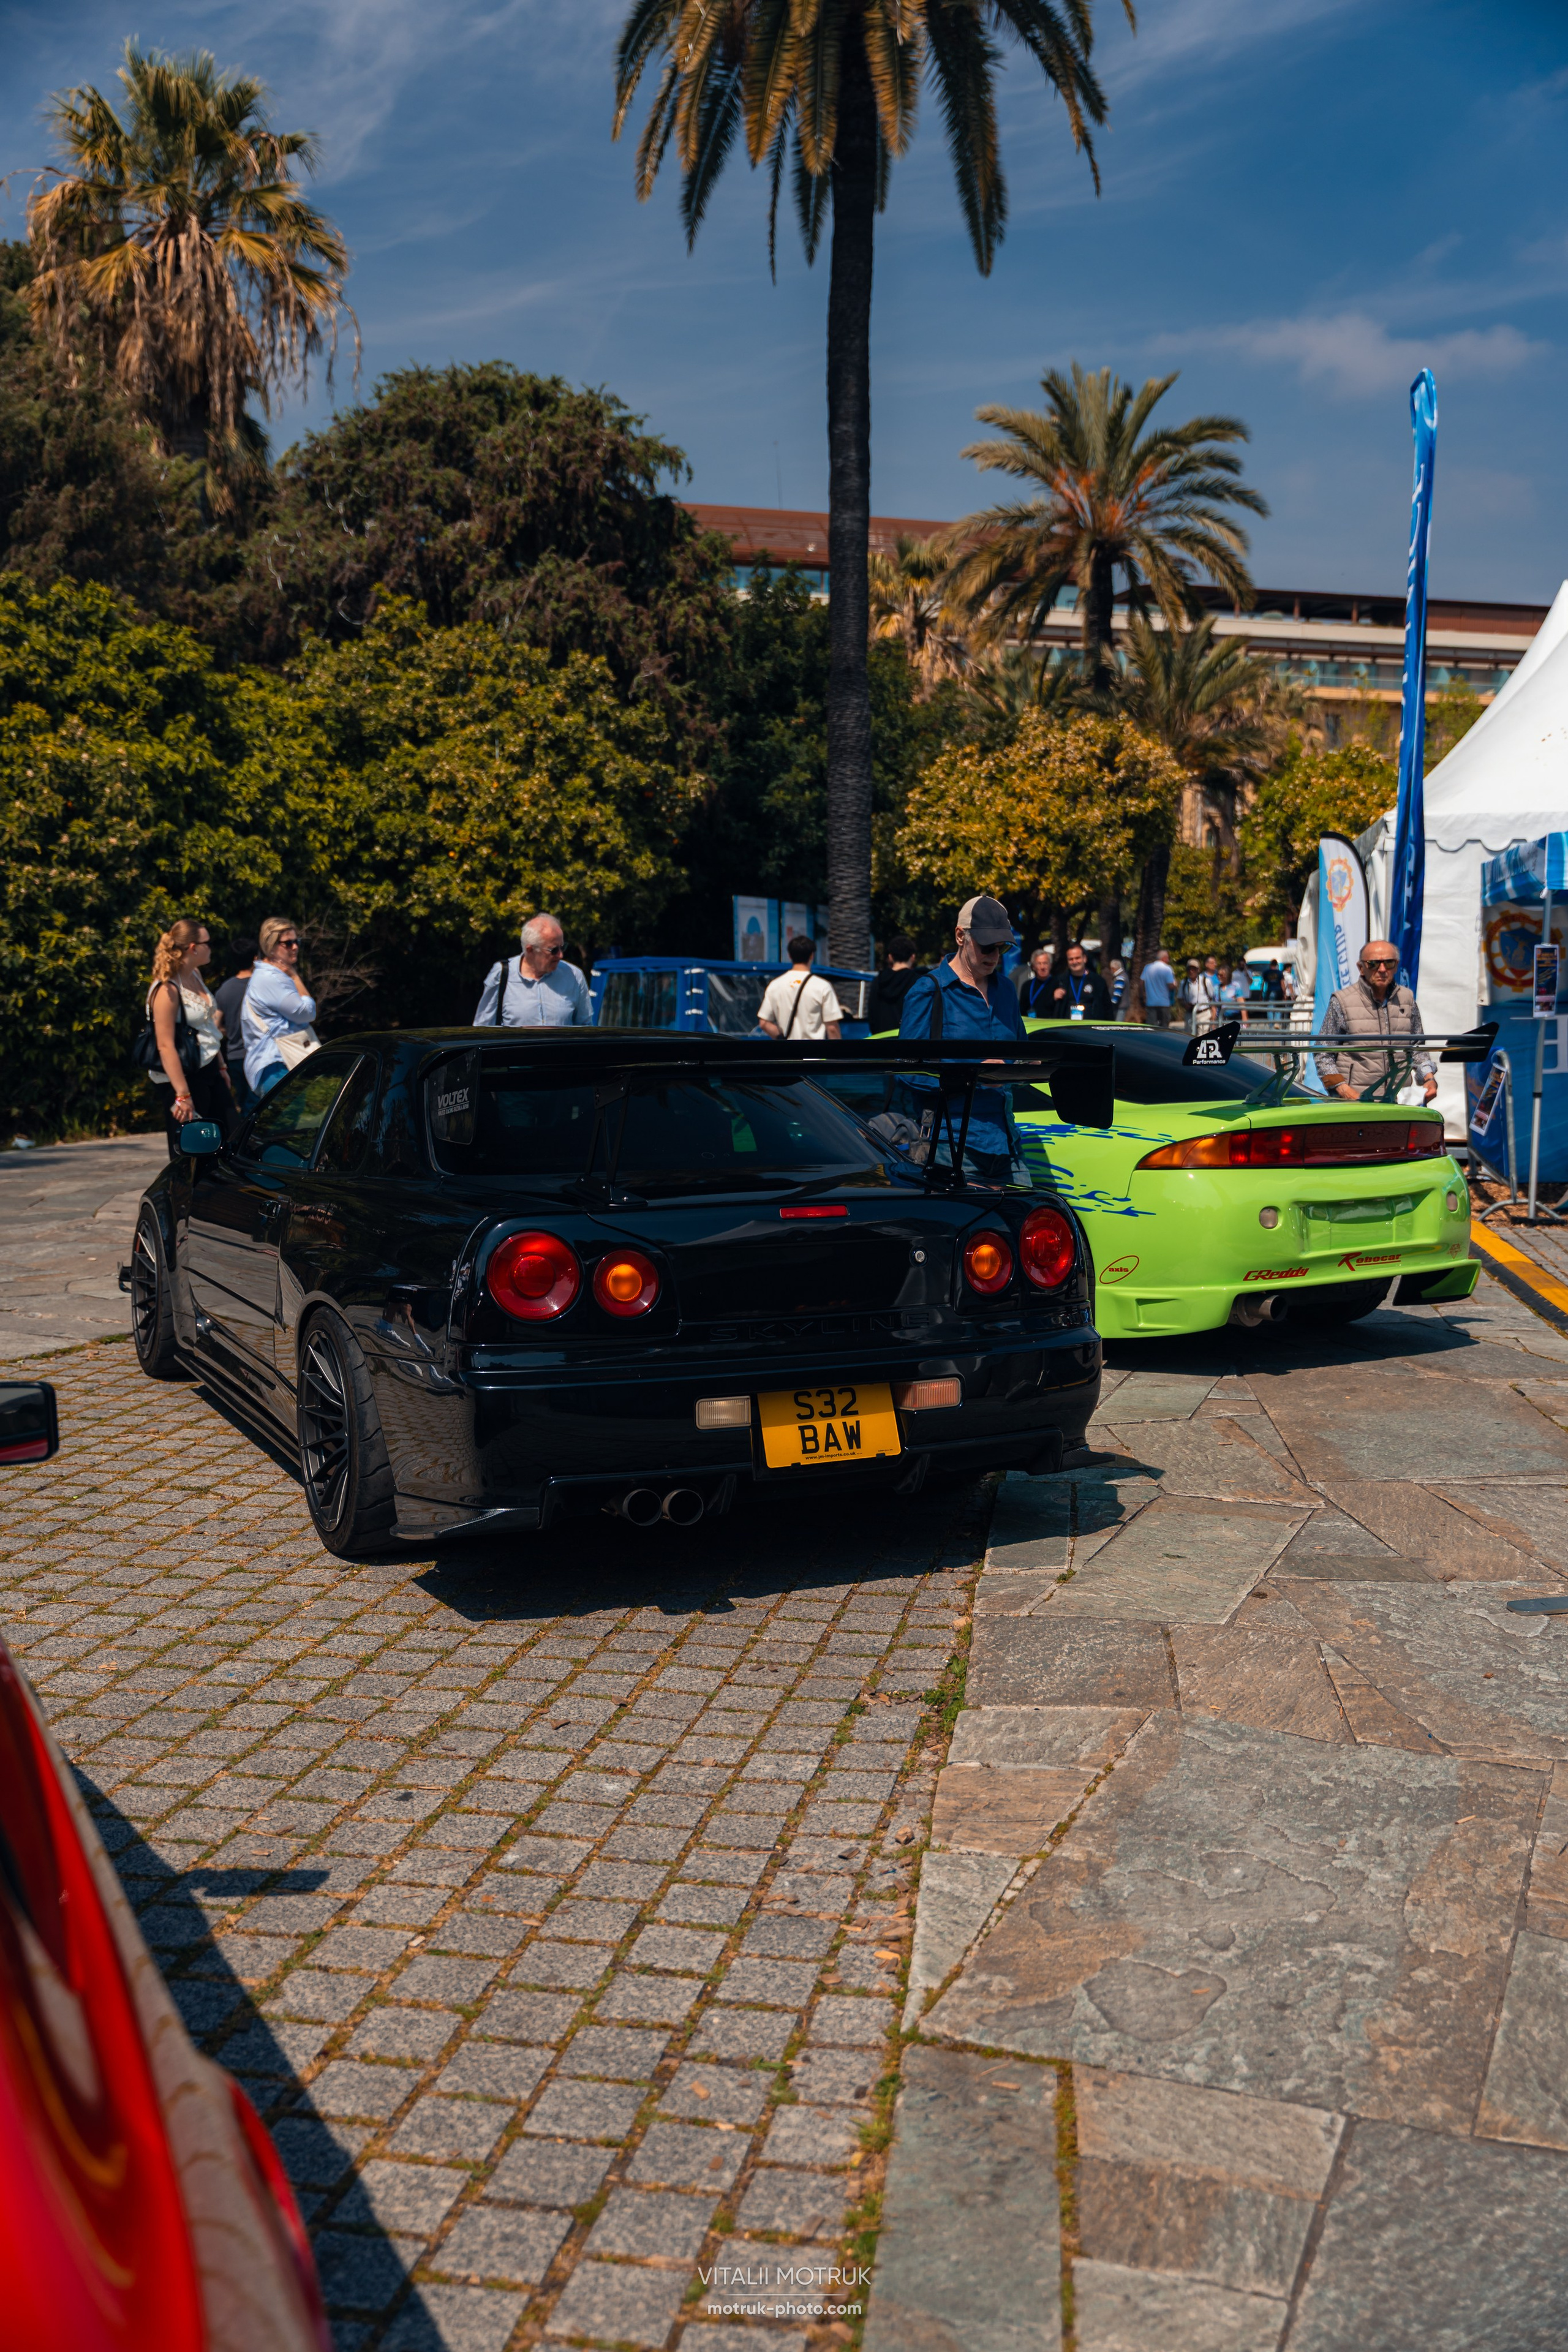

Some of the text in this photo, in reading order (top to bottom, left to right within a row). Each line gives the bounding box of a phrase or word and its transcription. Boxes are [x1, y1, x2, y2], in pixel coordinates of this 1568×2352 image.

[437, 1087, 469, 1109] VOLTEX
[1337, 1251, 1401, 1272] Robocar
[709, 1313, 930, 1342] SKYLINE
[794, 1387, 859, 1420] S32
[797, 1420, 861, 1455] BAW
[805, 1451, 856, 1460] www.jm-imports.co.uk
